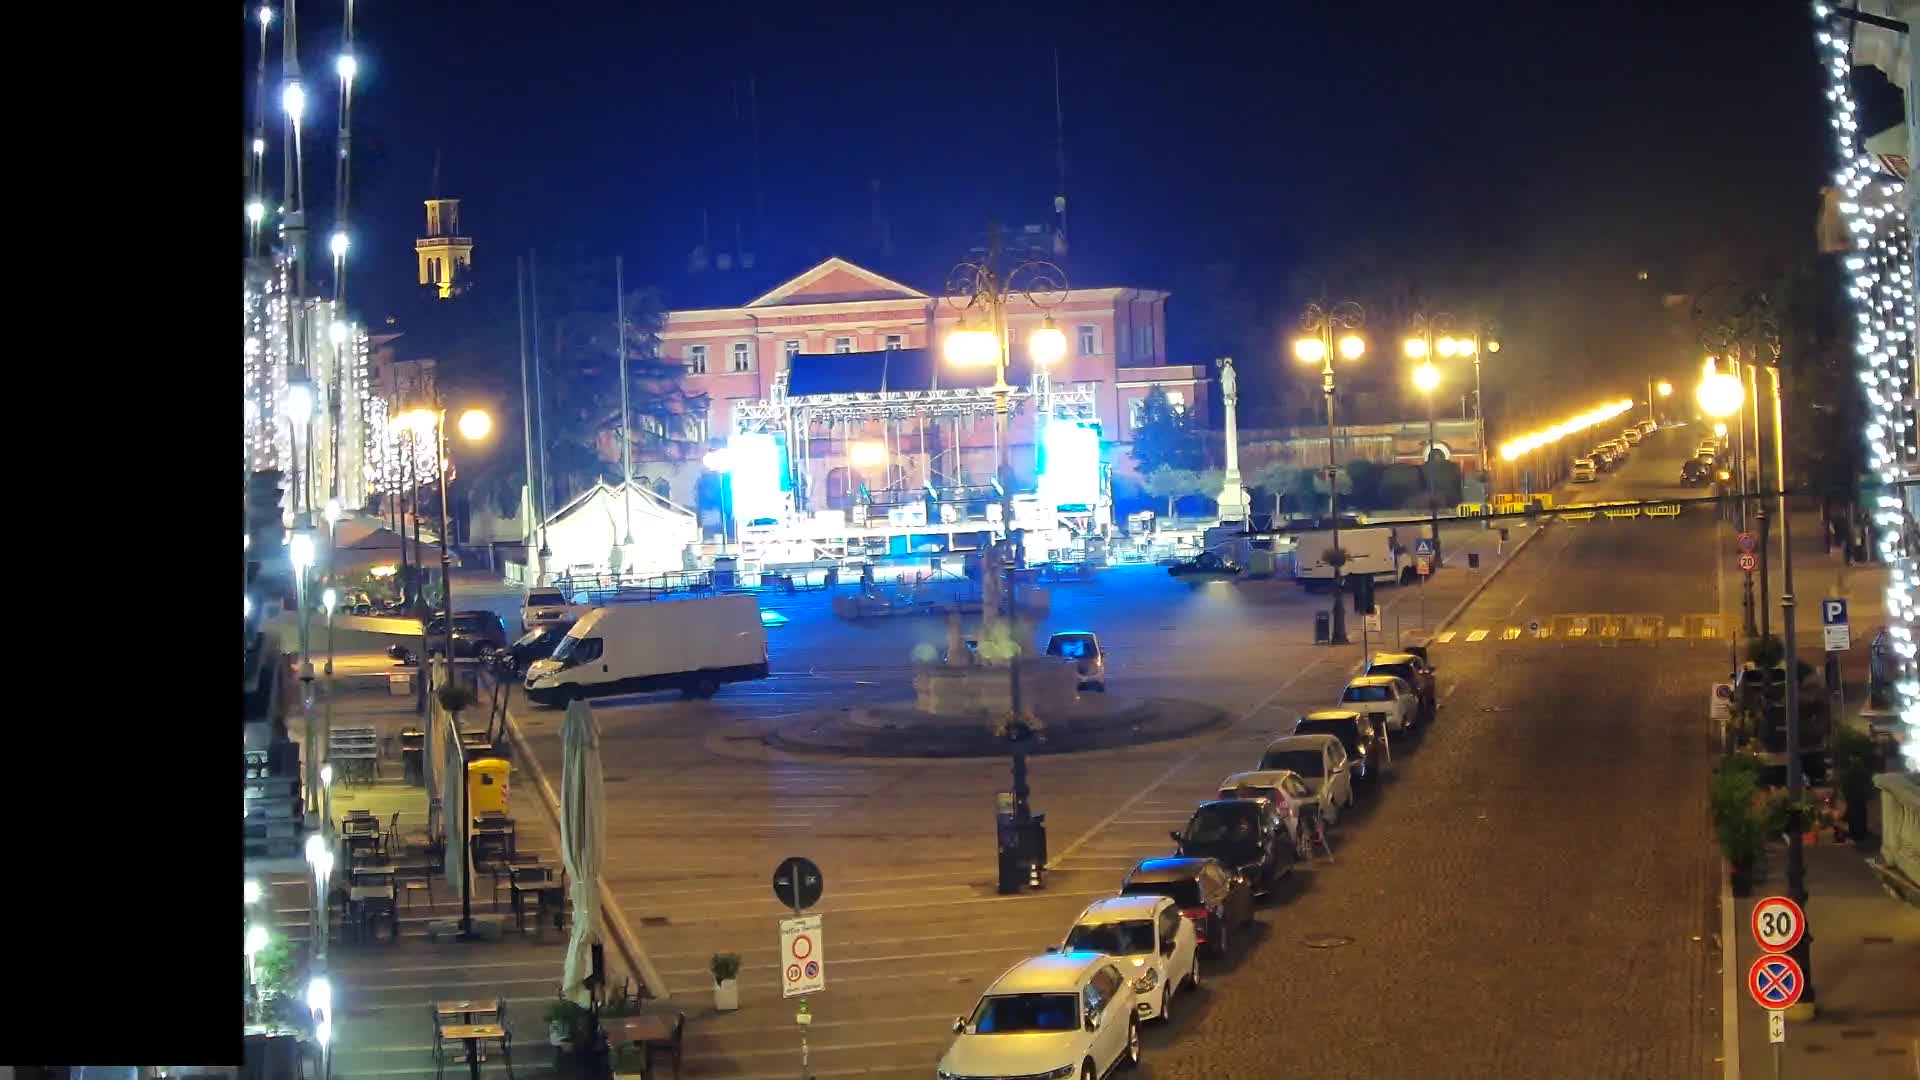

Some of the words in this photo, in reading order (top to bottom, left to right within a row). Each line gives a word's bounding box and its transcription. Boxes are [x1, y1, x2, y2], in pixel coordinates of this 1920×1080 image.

[1742, 557, 1753, 567] 20
[1827, 602, 1842, 622] P
[1762, 911, 1792, 938] 30
